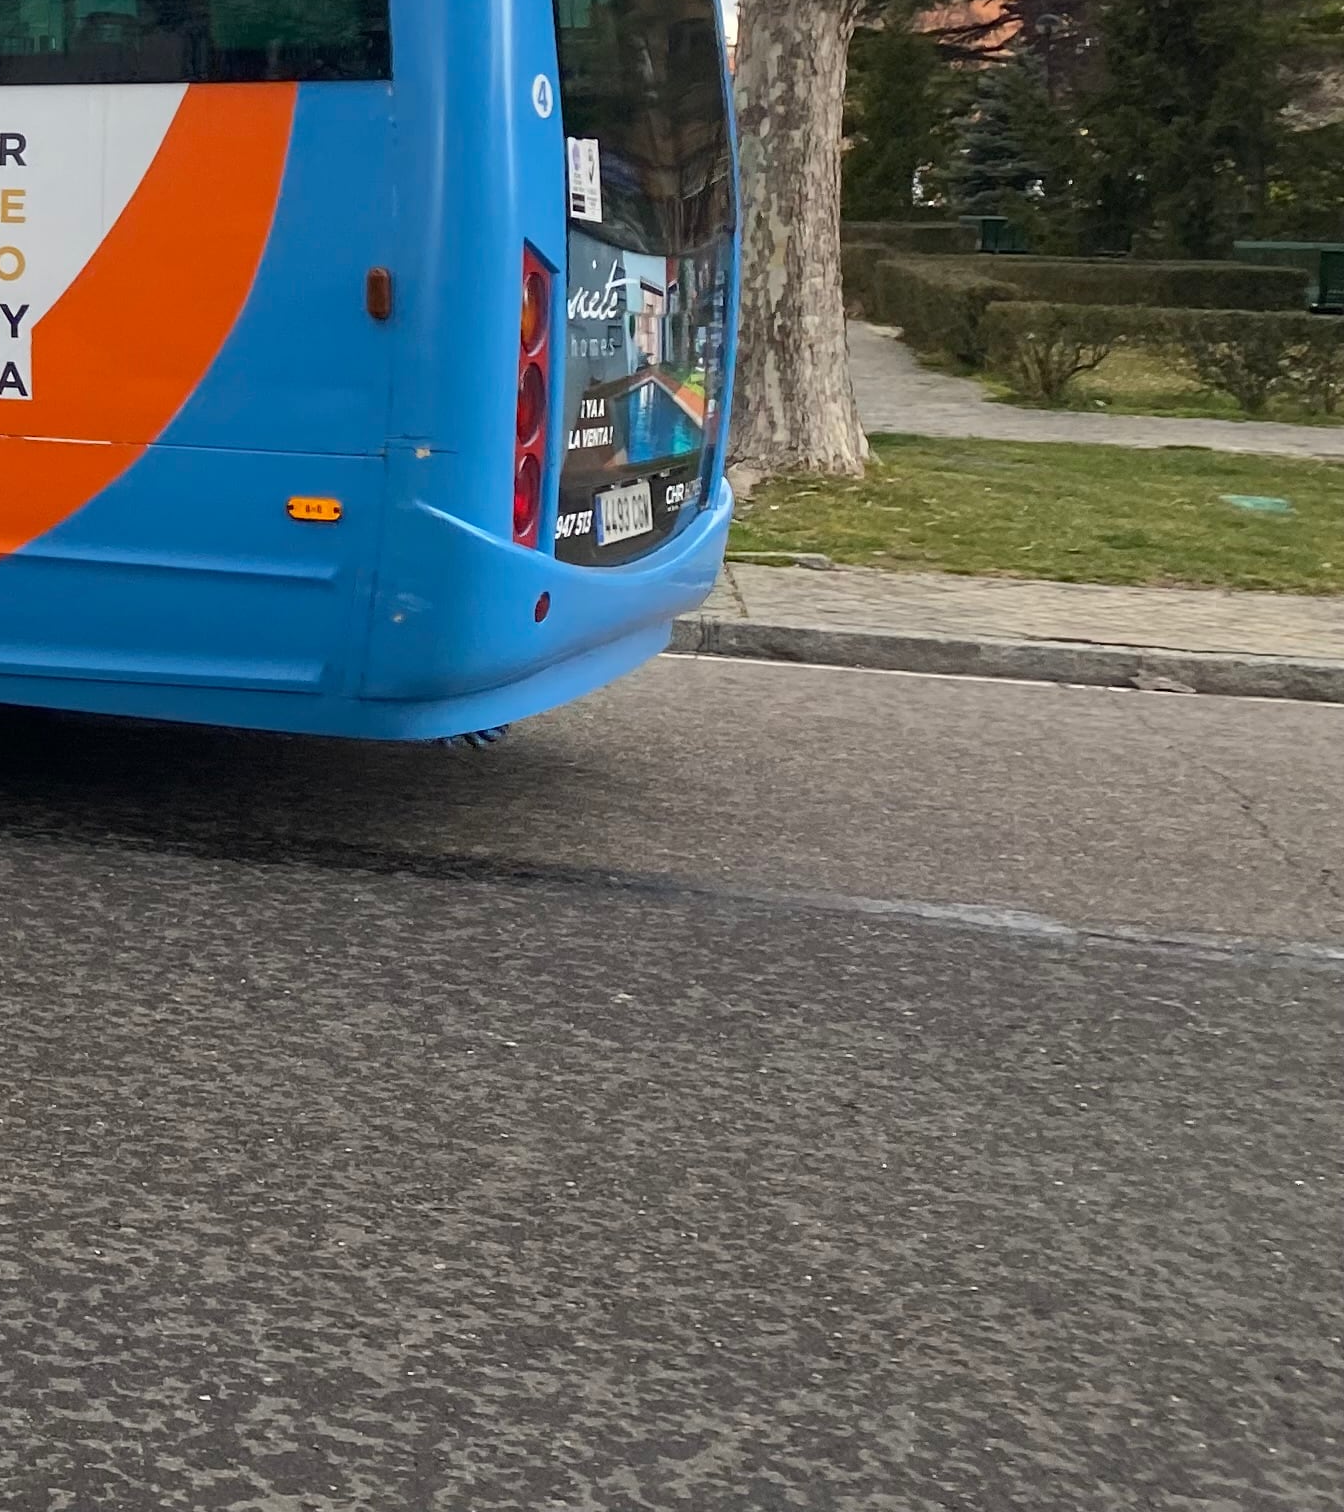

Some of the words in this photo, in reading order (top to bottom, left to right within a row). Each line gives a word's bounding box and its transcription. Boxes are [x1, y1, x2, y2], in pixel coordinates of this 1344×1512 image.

[537, 80, 548, 112] 4
[568, 429, 581, 450] LA
[582, 426, 614, 448] VENTA!
[665, 482, 684, 505] CHR
[554, 513, 577, 540] 947
